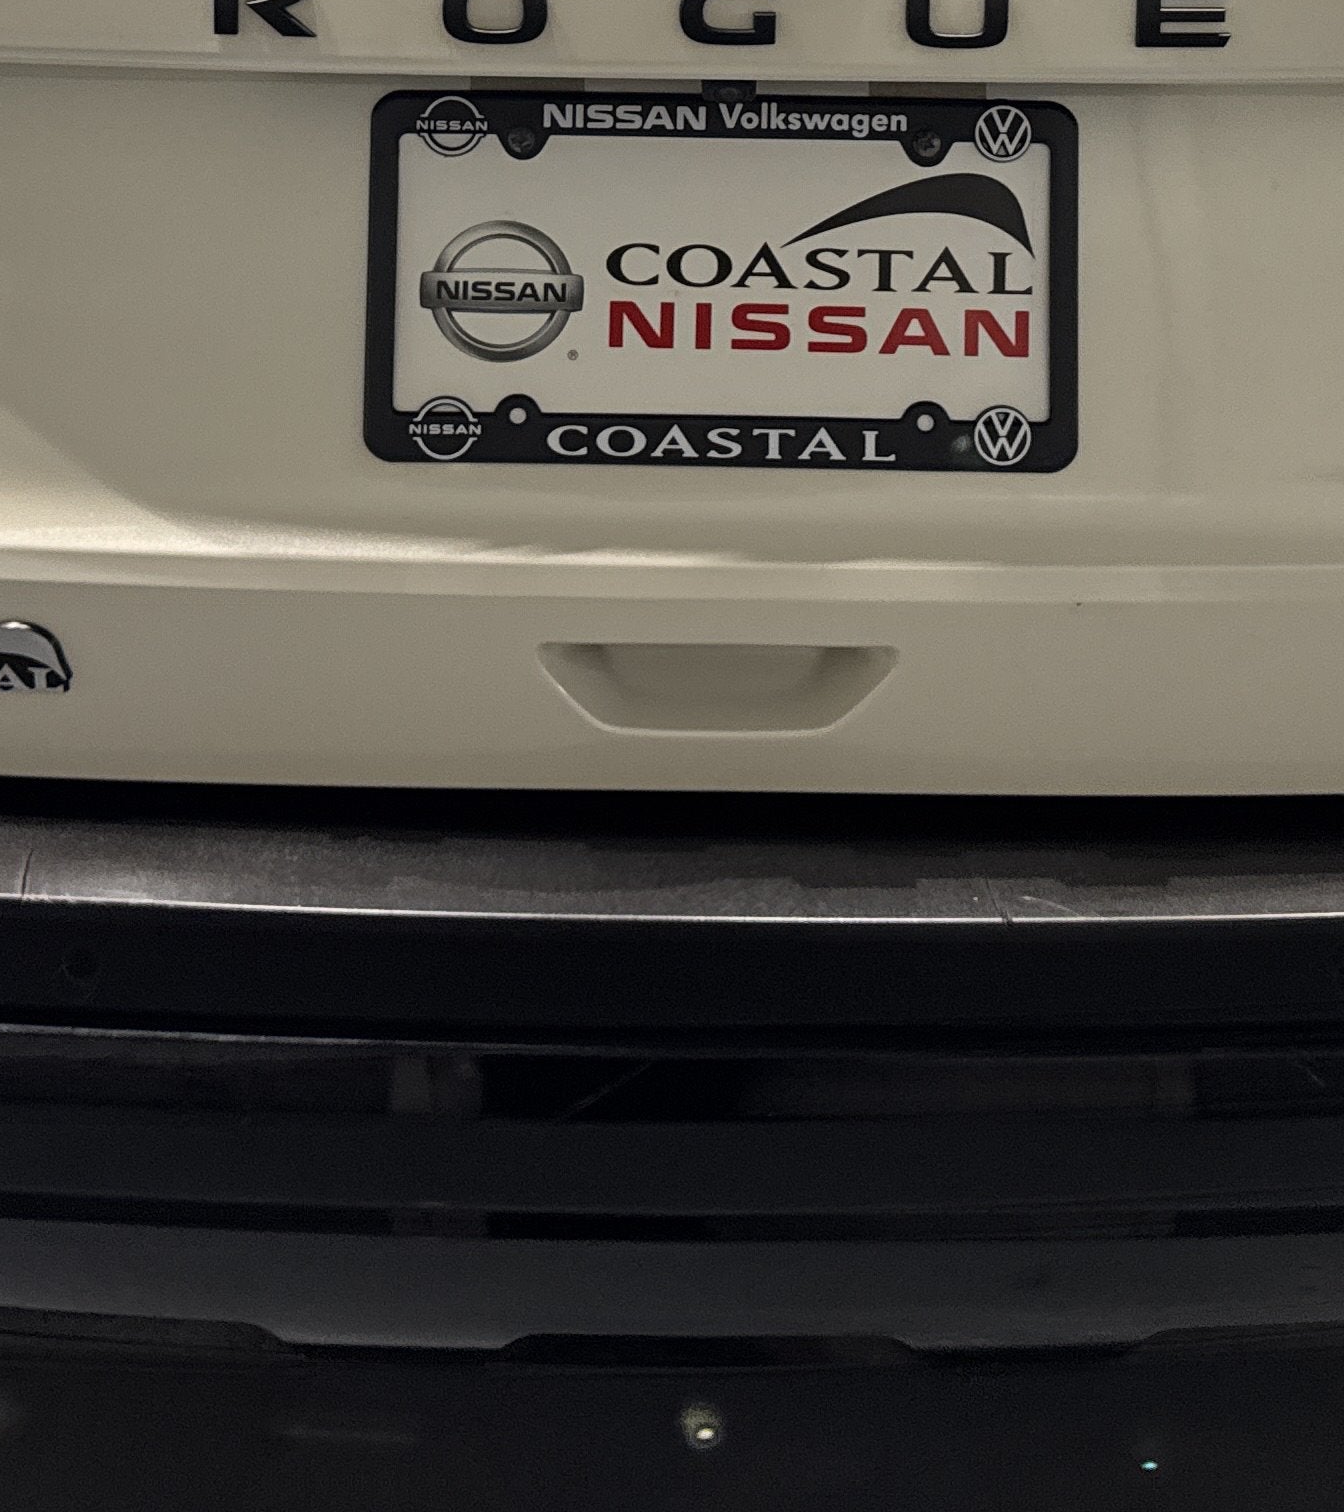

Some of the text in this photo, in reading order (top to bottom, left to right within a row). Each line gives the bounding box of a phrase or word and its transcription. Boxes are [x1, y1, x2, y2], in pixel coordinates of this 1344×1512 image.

[416, 118, 488, 132] NISSAN
[542, 103, 909, 137] NISSAN Volkswagen
[605, 240, 1034, 296] COASTAL
[436, 279, 568, 303] NISSAN
[607, 299, 1031, 358] NISSAN
[408, 423, 482, 436] NISSAN
[546, 424, 897, 462] COASTAL
